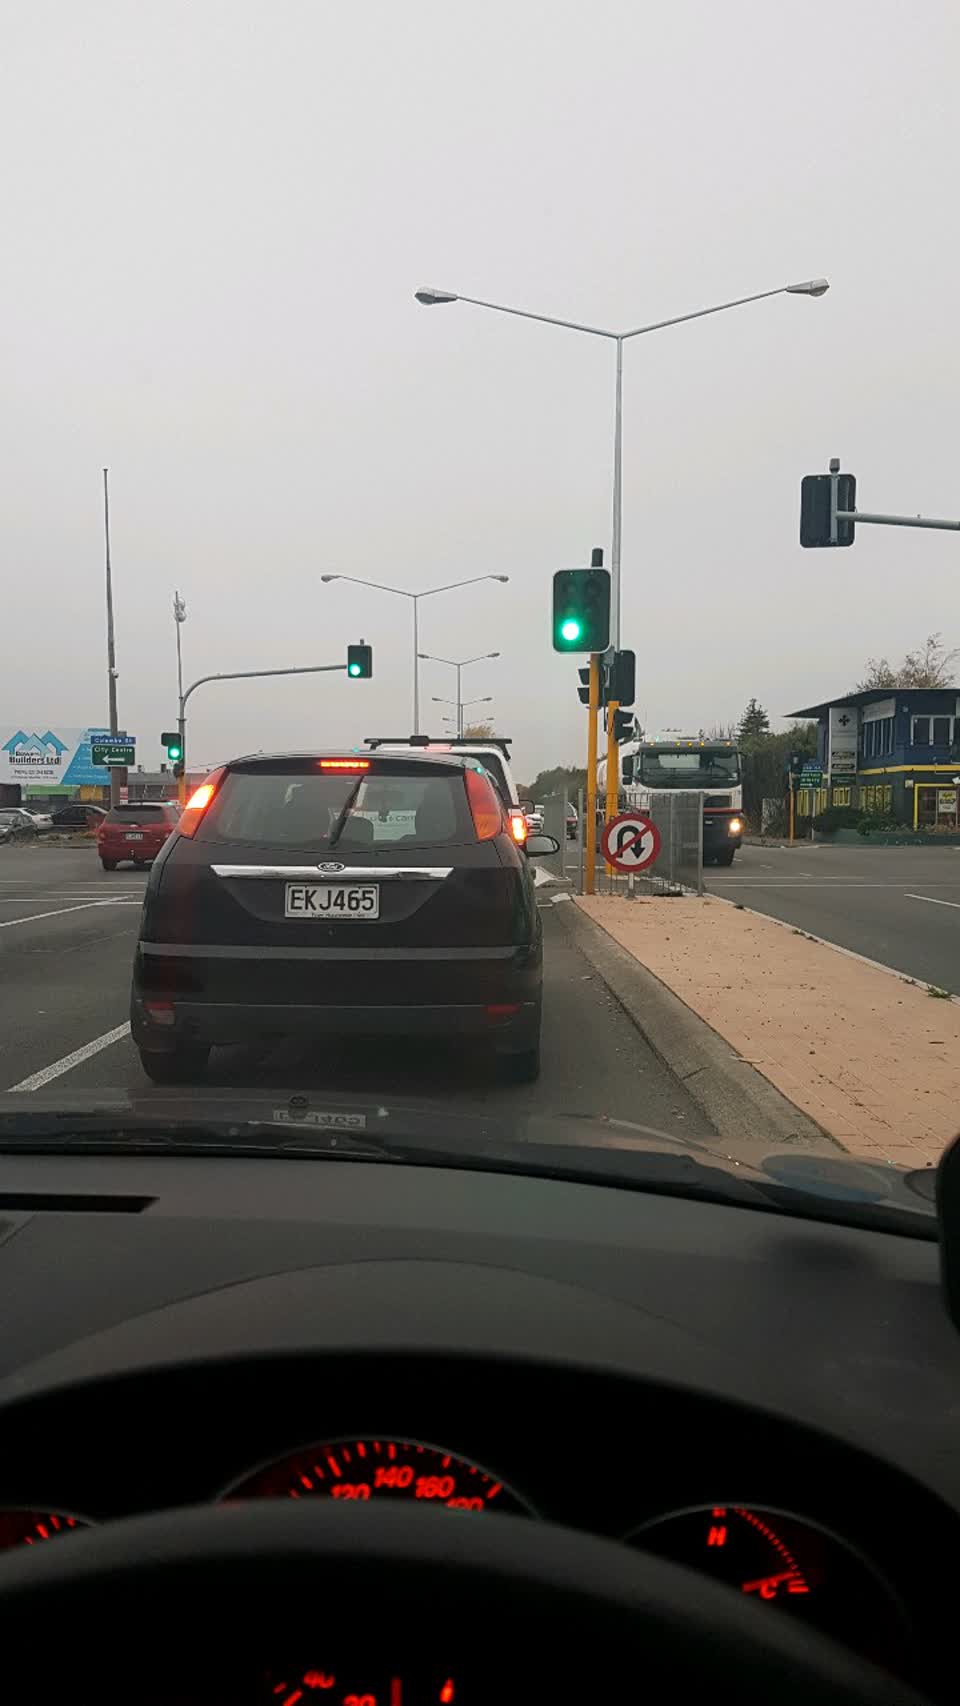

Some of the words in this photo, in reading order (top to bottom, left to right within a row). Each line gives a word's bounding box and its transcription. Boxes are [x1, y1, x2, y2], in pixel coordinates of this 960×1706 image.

[94, 746, 109, 754] City
[46, 756, 61, 764] Ltd
[290, 889, 374, 911] EKJ465
[374, 1465, 414, 1488] 140
